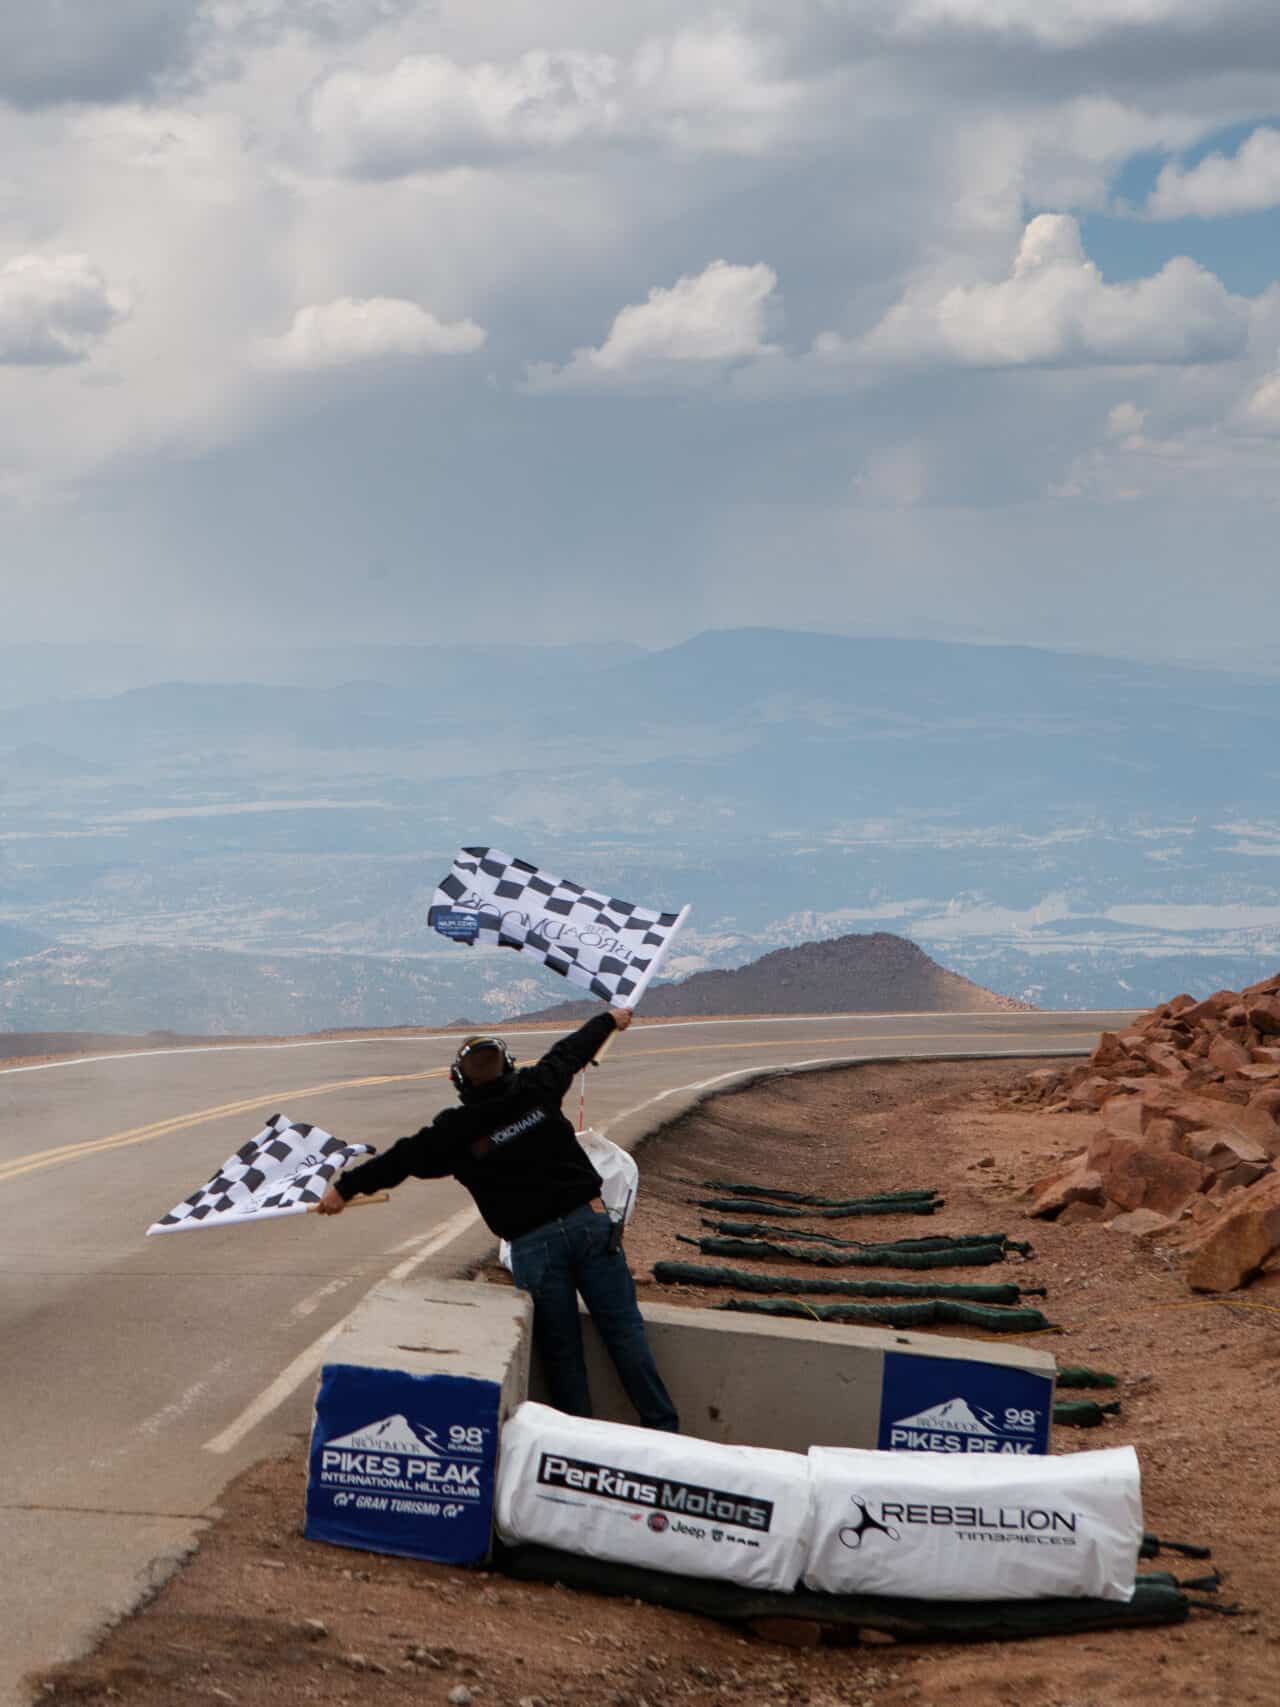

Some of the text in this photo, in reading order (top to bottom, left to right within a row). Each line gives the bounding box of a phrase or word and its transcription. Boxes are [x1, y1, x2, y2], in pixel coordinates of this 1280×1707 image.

[490, 1110, 546, 1144] YOKOHAMA
[890, 1430, 961, 1453] PIKES
[322, 1451, 481, 1487] PIKES PEAK
[321, 1472, 480, 1497] INTERNATIONAL HILL CLIMB
[543, 1457, 658, 1504] Perkins
[662, 1483, 768, 1527] Motors
[355, 1495, 441, 1517] GRAN TURISMO
[671, 1519, 706, 1540] Jeep
